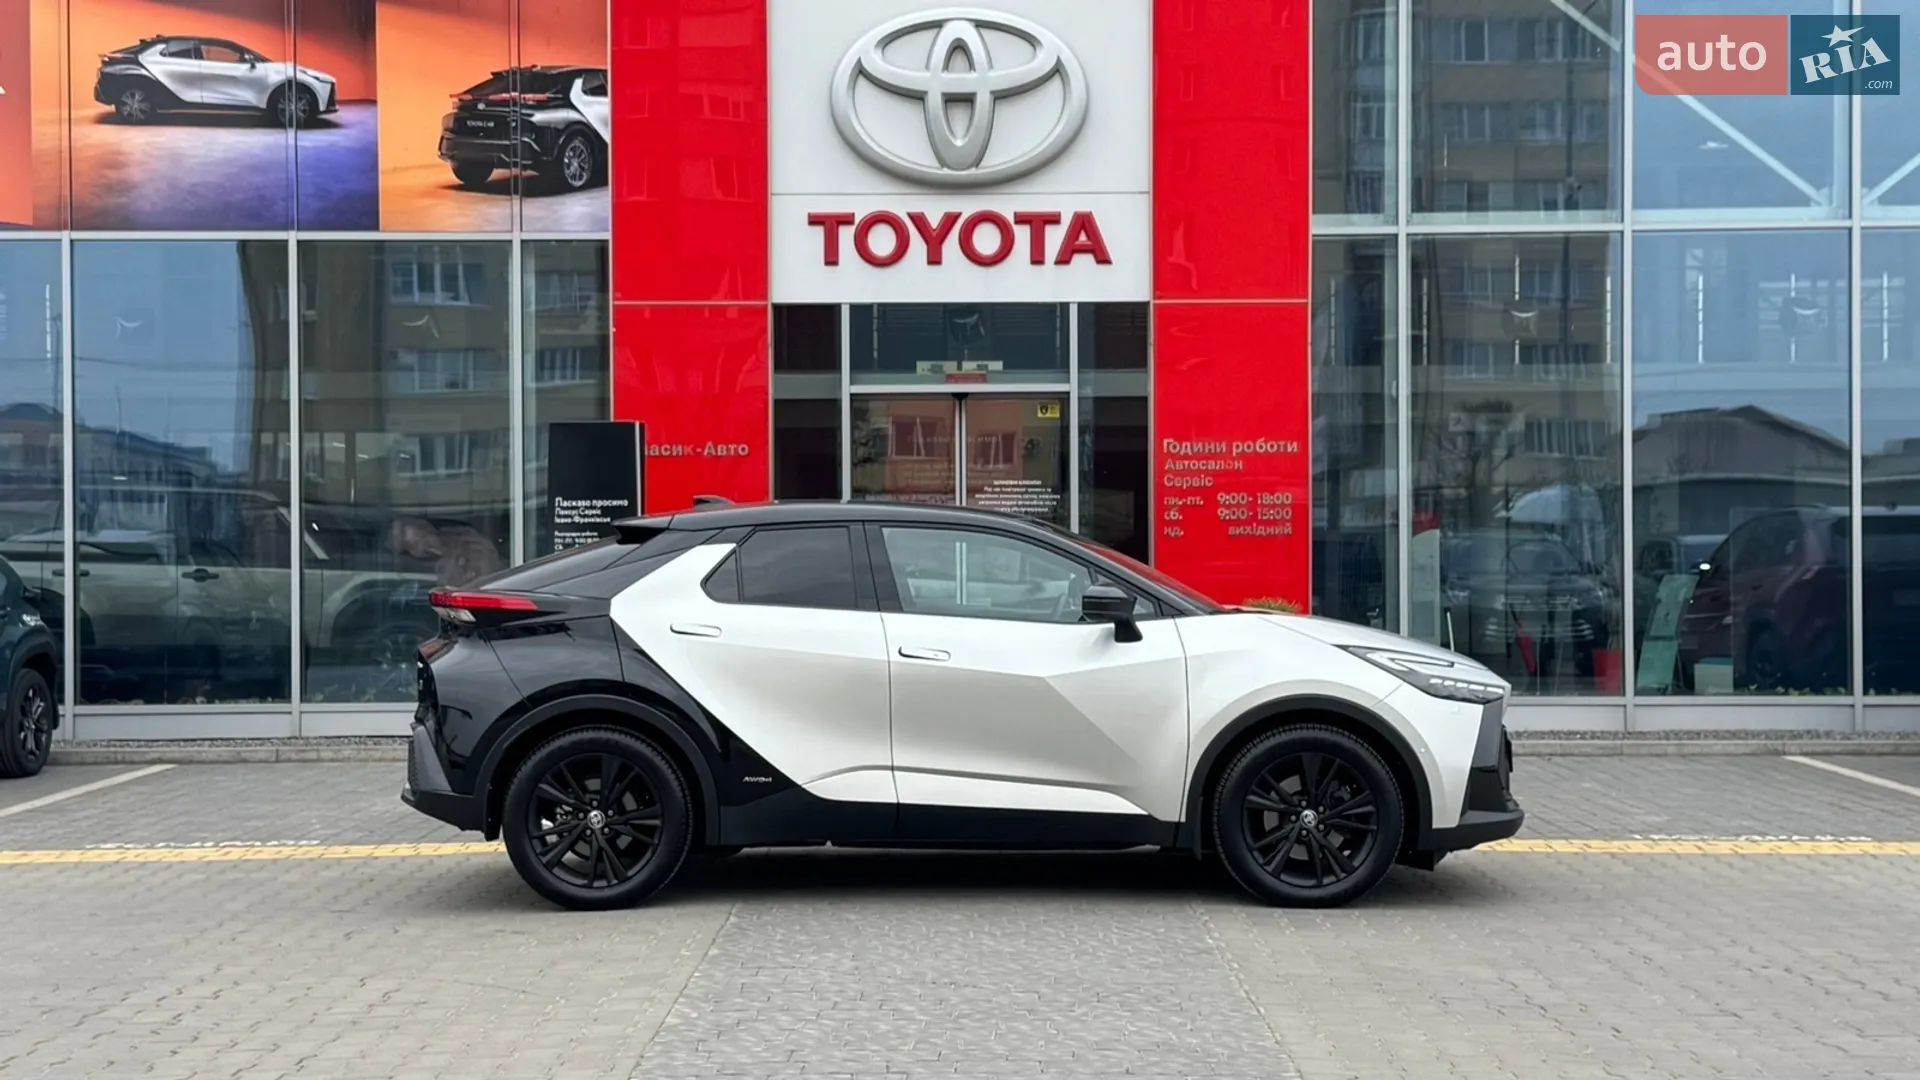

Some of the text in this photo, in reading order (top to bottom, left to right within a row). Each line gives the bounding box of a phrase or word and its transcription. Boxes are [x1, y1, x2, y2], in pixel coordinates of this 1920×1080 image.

[808, 210, 1113, 267] TOYOTA
[644, 441, 749, 456] асик-Авто
[1163, 437, 1298, 456] Години роботи
[1164, 458, 1243, 470] Автосалон
[1163, 474, 1214, 489] Сервіс
[1228, 523, 1293, 536] вихідний
